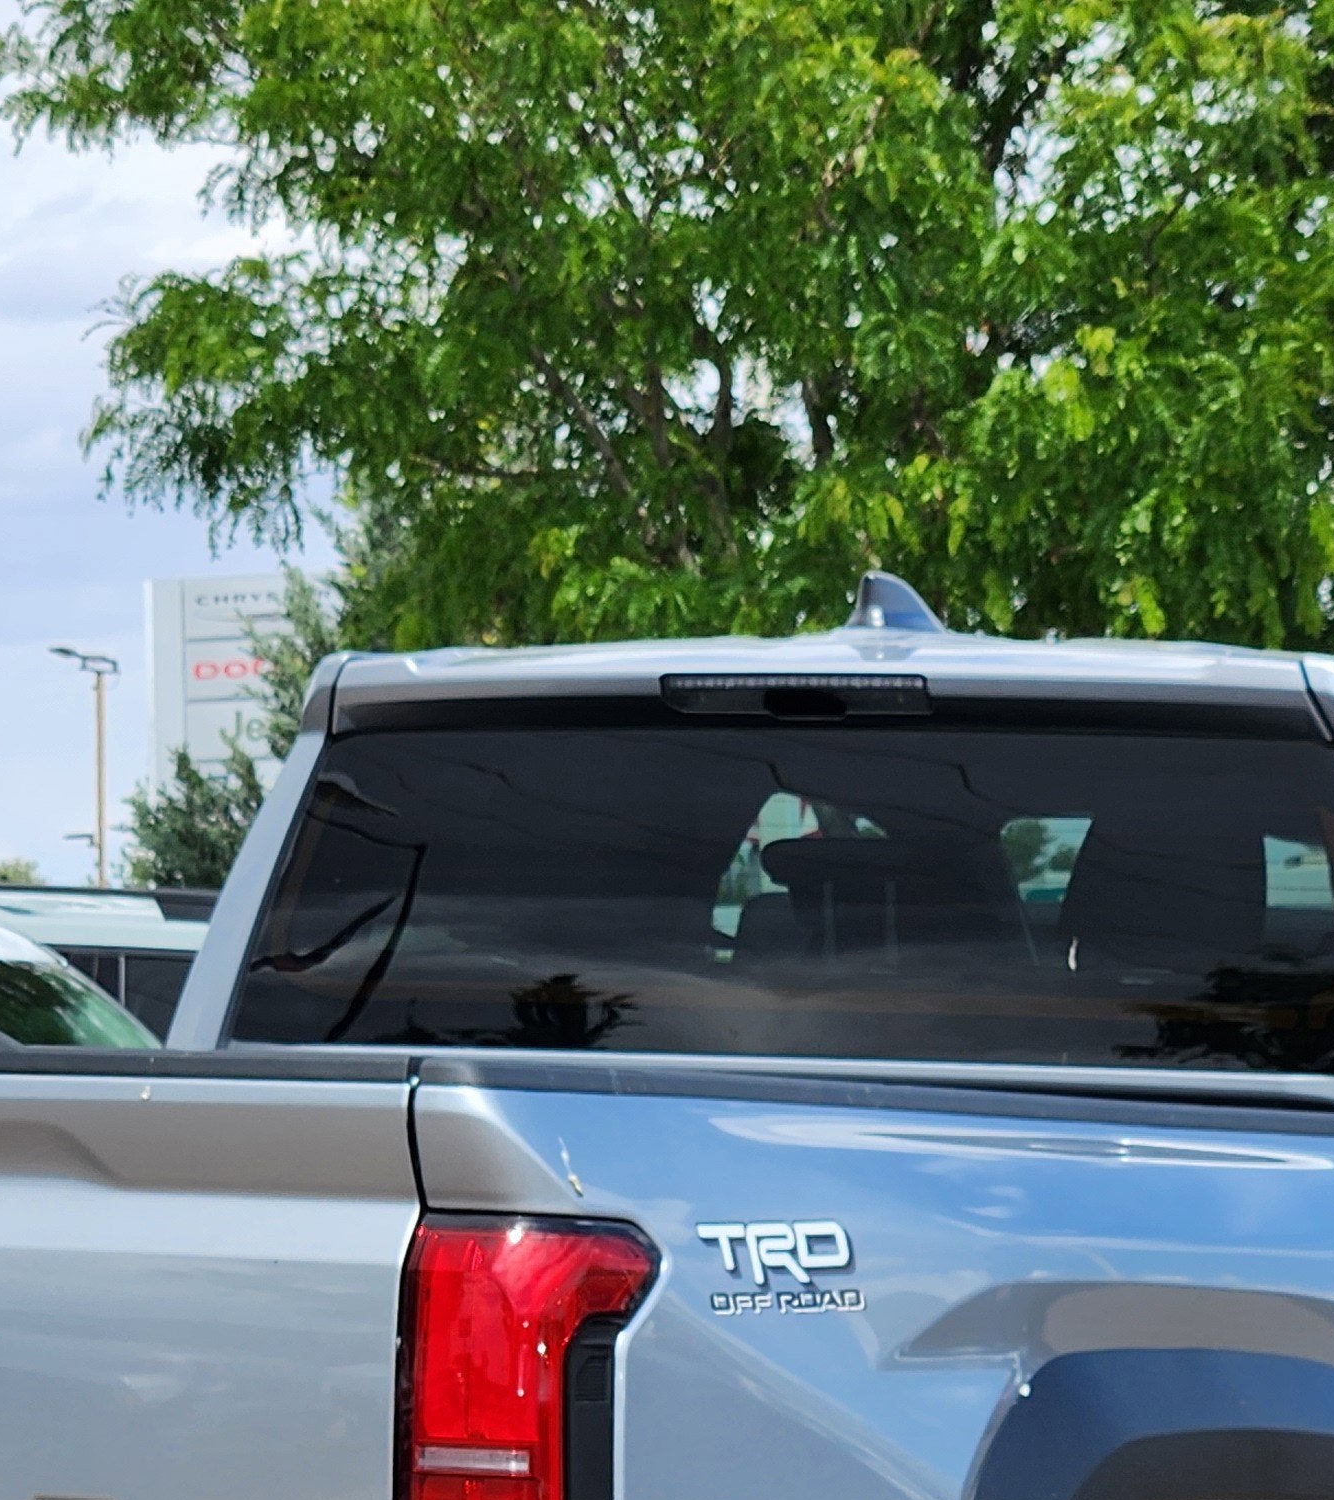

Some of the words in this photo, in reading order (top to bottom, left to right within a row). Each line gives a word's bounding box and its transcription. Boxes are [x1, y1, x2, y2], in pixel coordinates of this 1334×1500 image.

[231, 710, 266, 742] Je
[696, 1221, 851, 1286] TRD
[710, 1292, 772, 1316] OFF
[776, 1288, 866, 1315] ROAD
